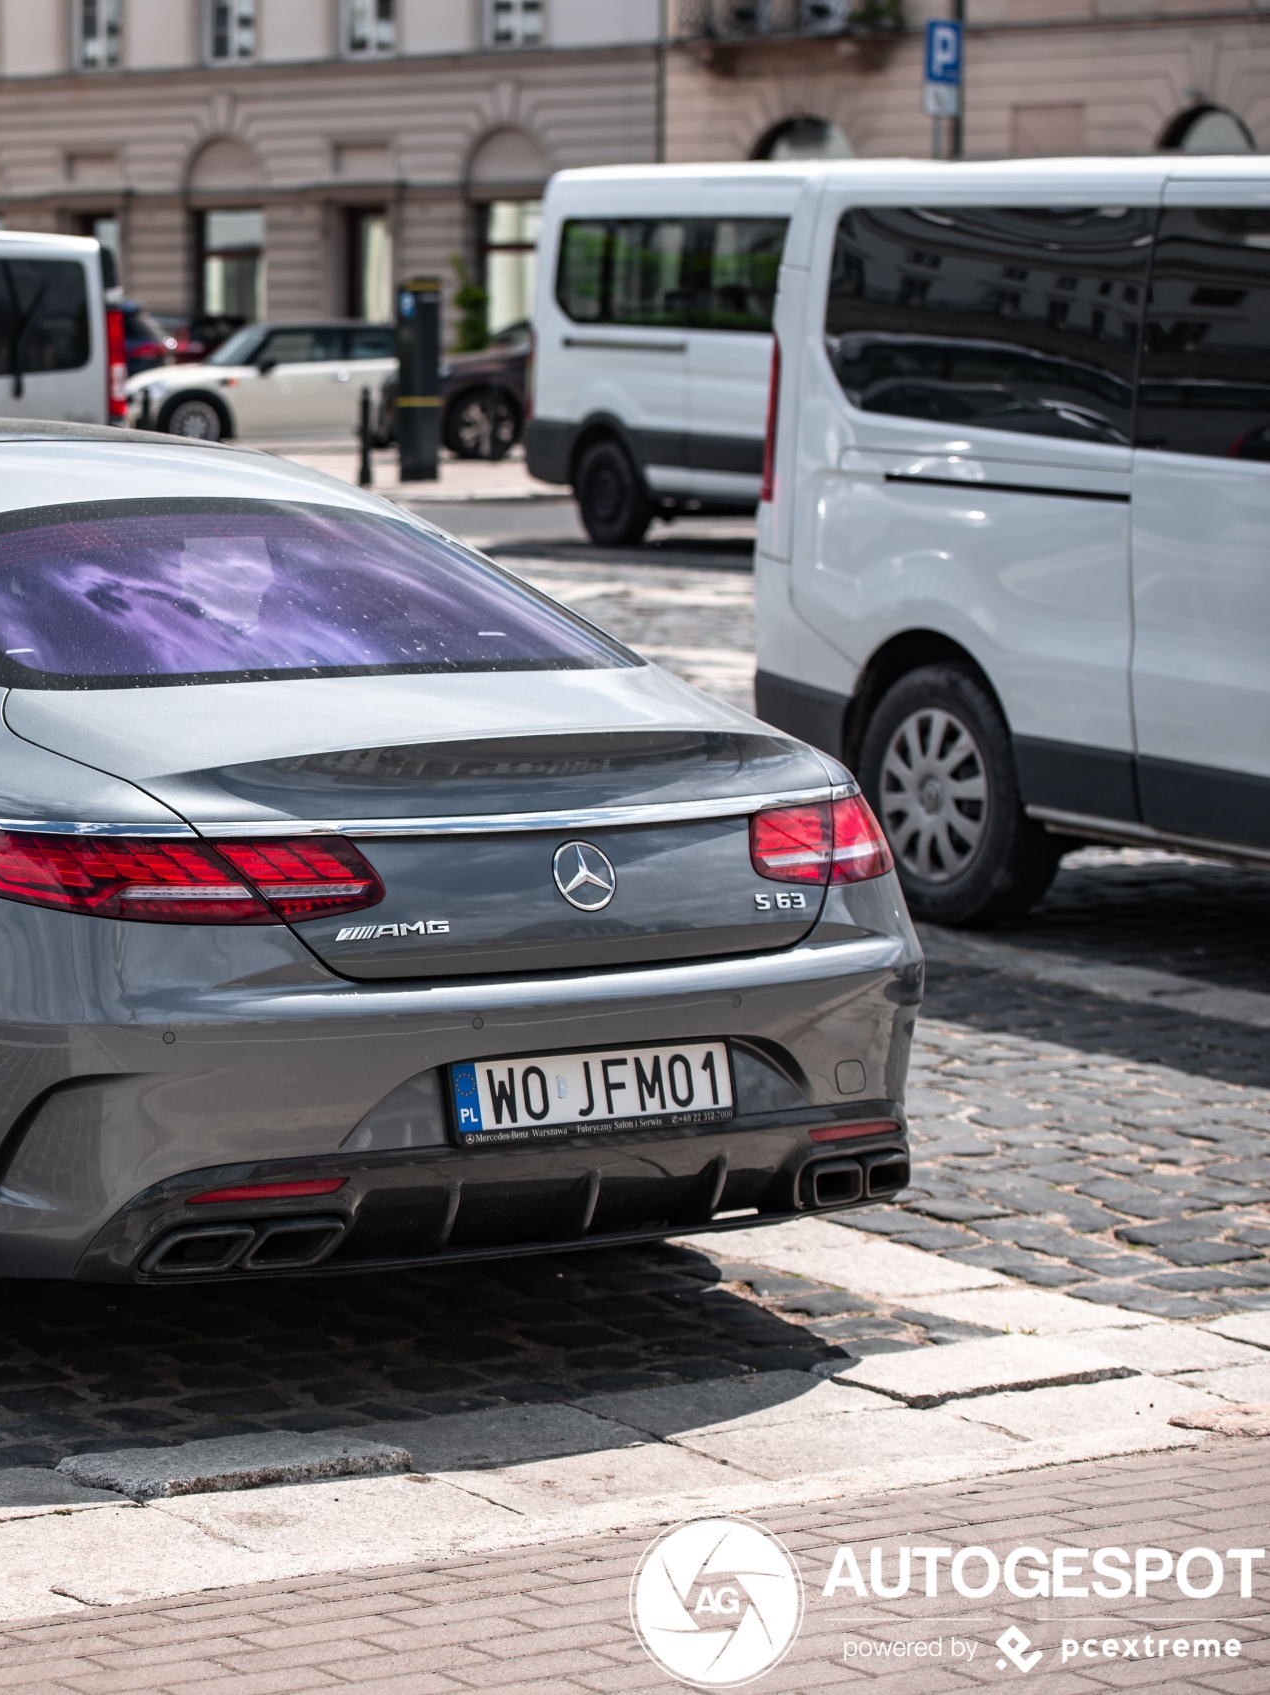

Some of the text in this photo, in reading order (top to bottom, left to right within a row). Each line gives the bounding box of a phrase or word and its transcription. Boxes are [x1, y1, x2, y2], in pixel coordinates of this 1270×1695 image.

[932, 27, 958, 77] P
[755, 892, 807, 910] S 63
[372, 920, 450, 939] AMG
[460, 1108, 479, 1123] PL
[475, 1130, 529, 1143] Mercedes-Benz
[532, 1126, 568, 1138] Warszawa
[576, 1121, 613, 1134] Fabryczny
[614, 1119, 634, 1130] Salon
[639, 1117, 663, 1128] Serwis
[678, 1112, 692, 1123] +48
[693, 1112, 702, 1123] 22
[703, 1111, 715, 1121] 312
[716, 1109, 734, 1120] 7000
